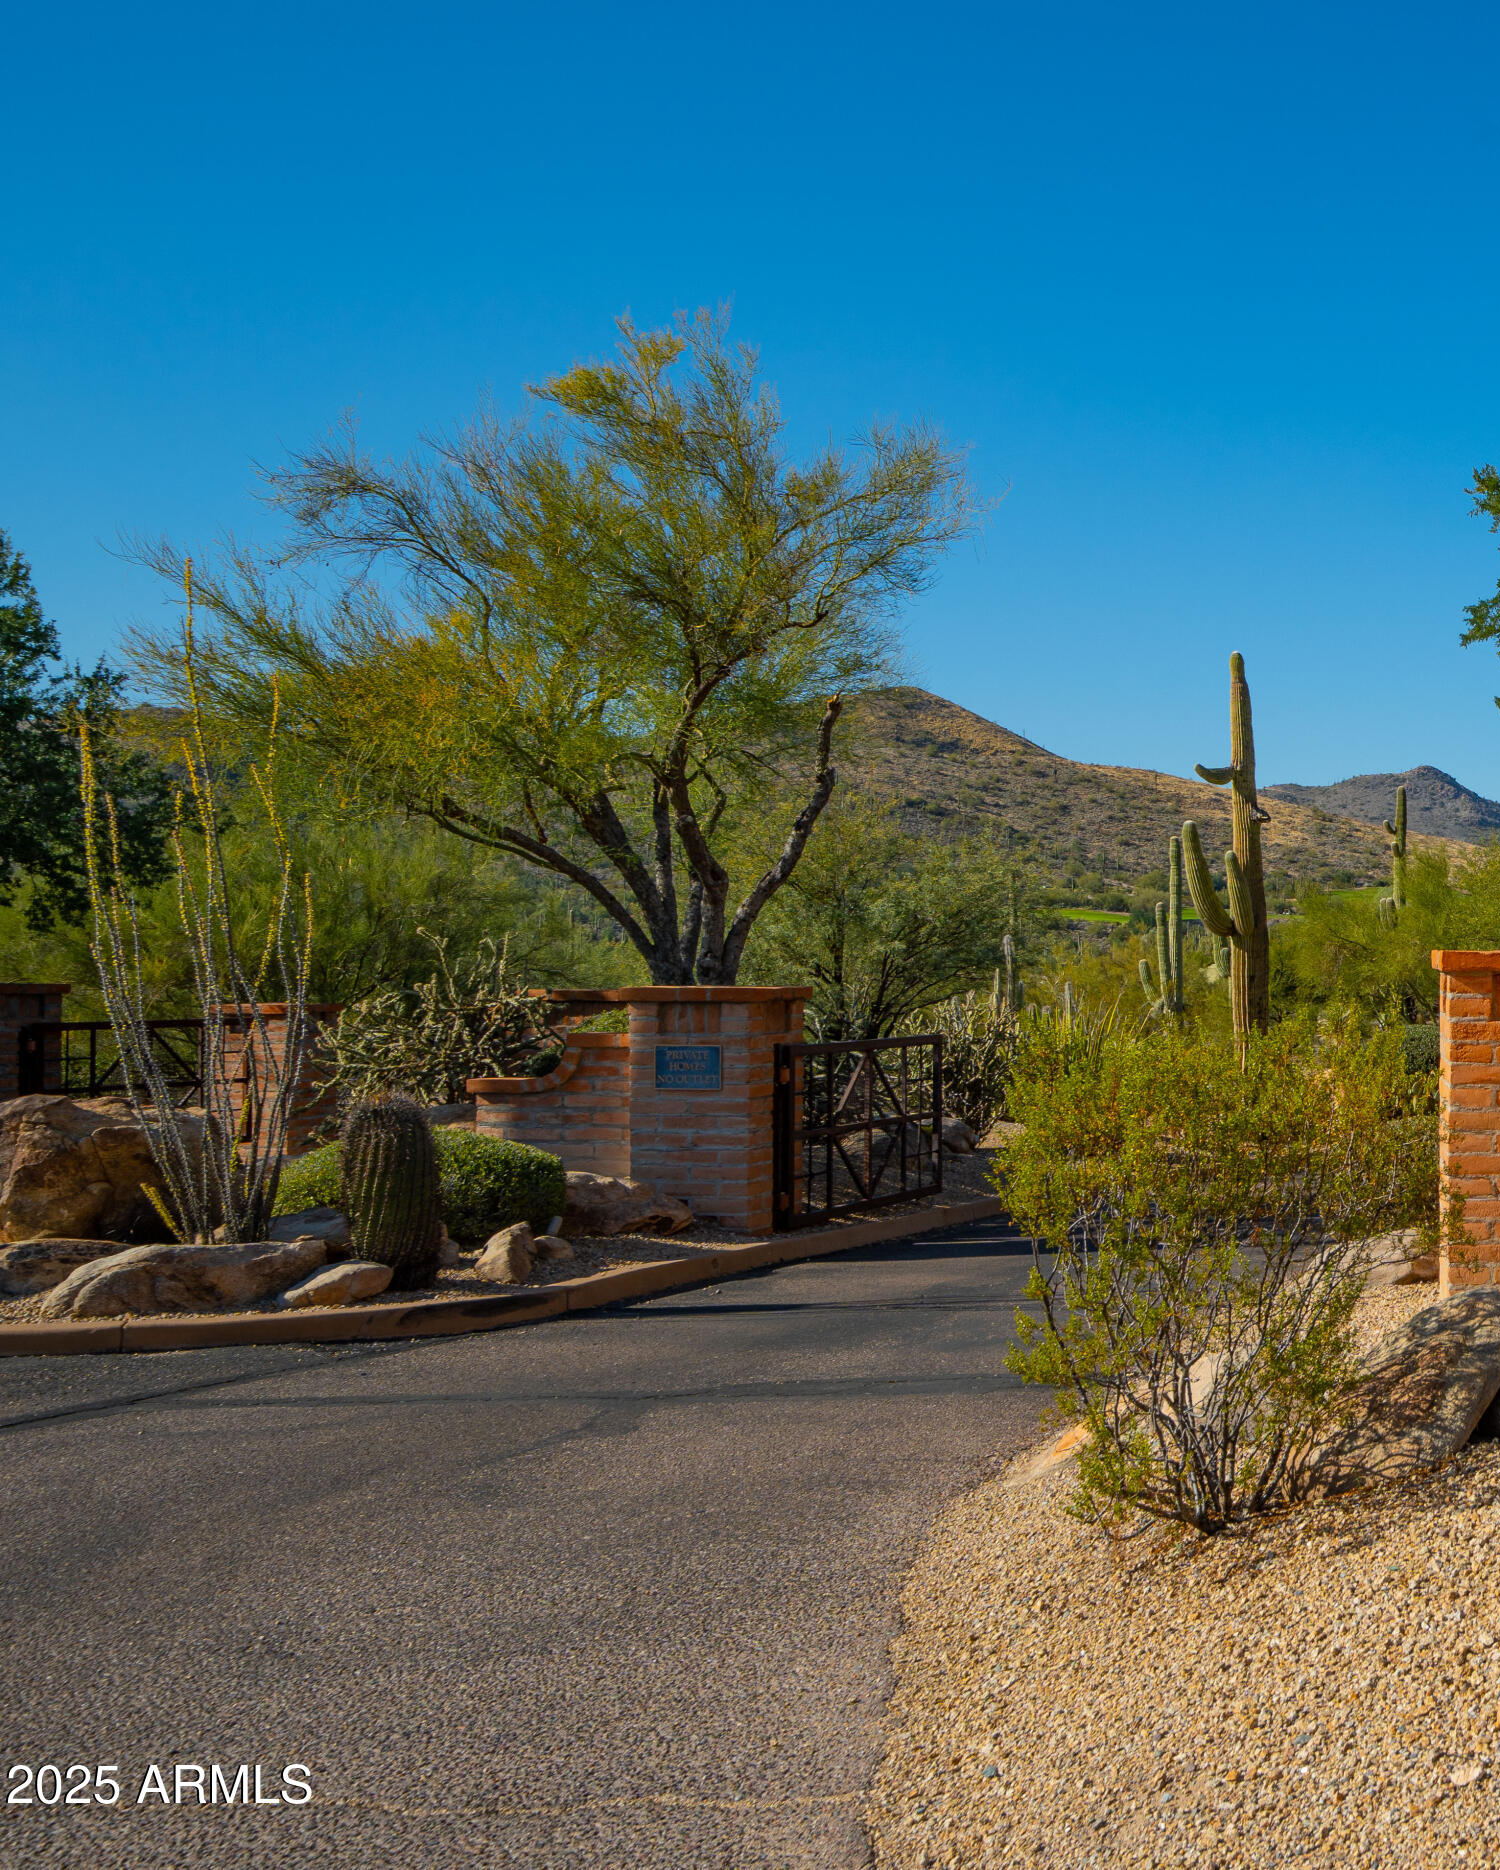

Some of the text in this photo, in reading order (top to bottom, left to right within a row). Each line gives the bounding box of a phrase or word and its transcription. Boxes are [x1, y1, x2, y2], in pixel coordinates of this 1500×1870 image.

[665, 1050, 710, 1060] PRIVATE
[668, 1062, 706, 1072] HOMES
[657, 1074, 717, 1085] NO OUTLET
